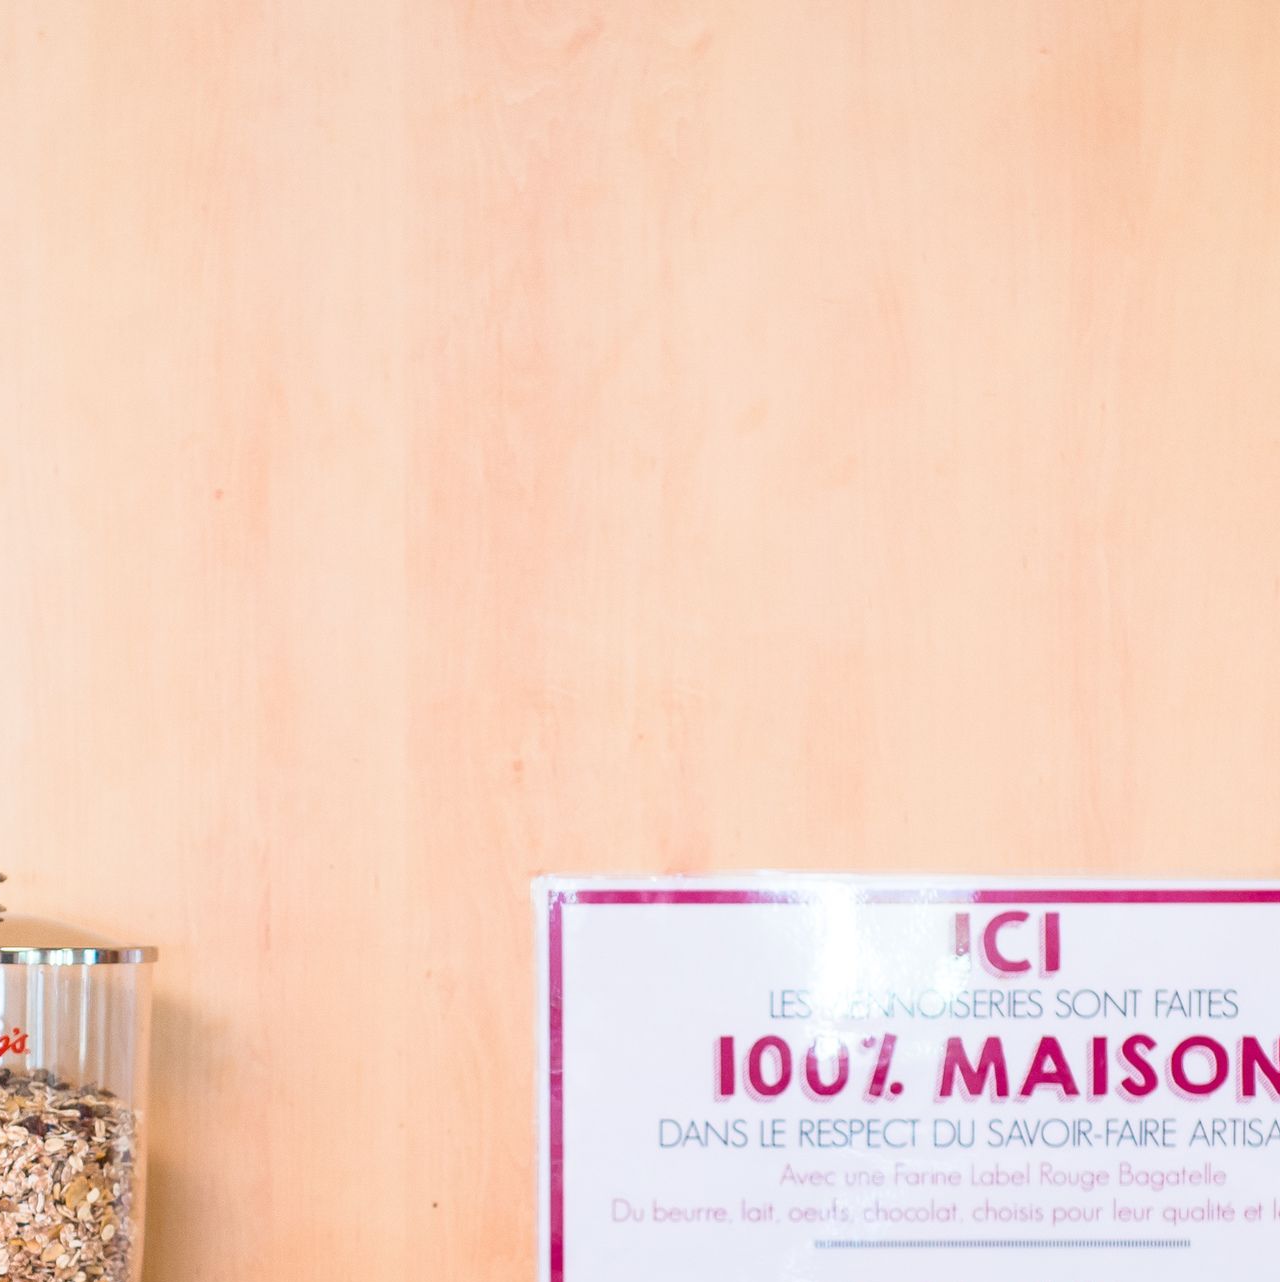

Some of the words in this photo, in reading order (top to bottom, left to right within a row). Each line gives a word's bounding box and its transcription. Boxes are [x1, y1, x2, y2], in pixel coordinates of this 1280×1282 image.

[952, 911, 1061, 976] ICI
[770, 989, 812, 1019] LES
[1055, 988, 1142, 1019] SONT
[1154, 988, 1239, 1019] FAITES
[713, 1034, 904, 1101] 100%
[658, 1118, 748, 1149] DANS
[760, 1118, 787, 1149] LE
[798, 1118, 920, 1149] RESPECT
[932, 1118, 975, 1149] DU
[987, 1117, 1177, 1149] SAVOIR-FAIRE
[779, 1163, 835, 1187] Avec
[845, 1170, 886, 1187] une
[893, 1162, 962, 1187] Farine
[971, 1162, 1030, 1187] Label
[1040, 1162, 1110, 1192] Rouge
[1119, 1161, 1228, 1192] Bagatelle
[611, 1198, 645, 1223] Du
[652, 1199, 733, 1225] beurre,
[741, 1199, 780, 1225] lait,
[972, 1198, 1044, 1223] choisis
[1052, 1203, 1104, 1227] pour
[1113, 1198, 1154, 1222] leur
[1162, 1198, 1235, 1227] qualité
[1243, 1201, 1264, 1223] et
